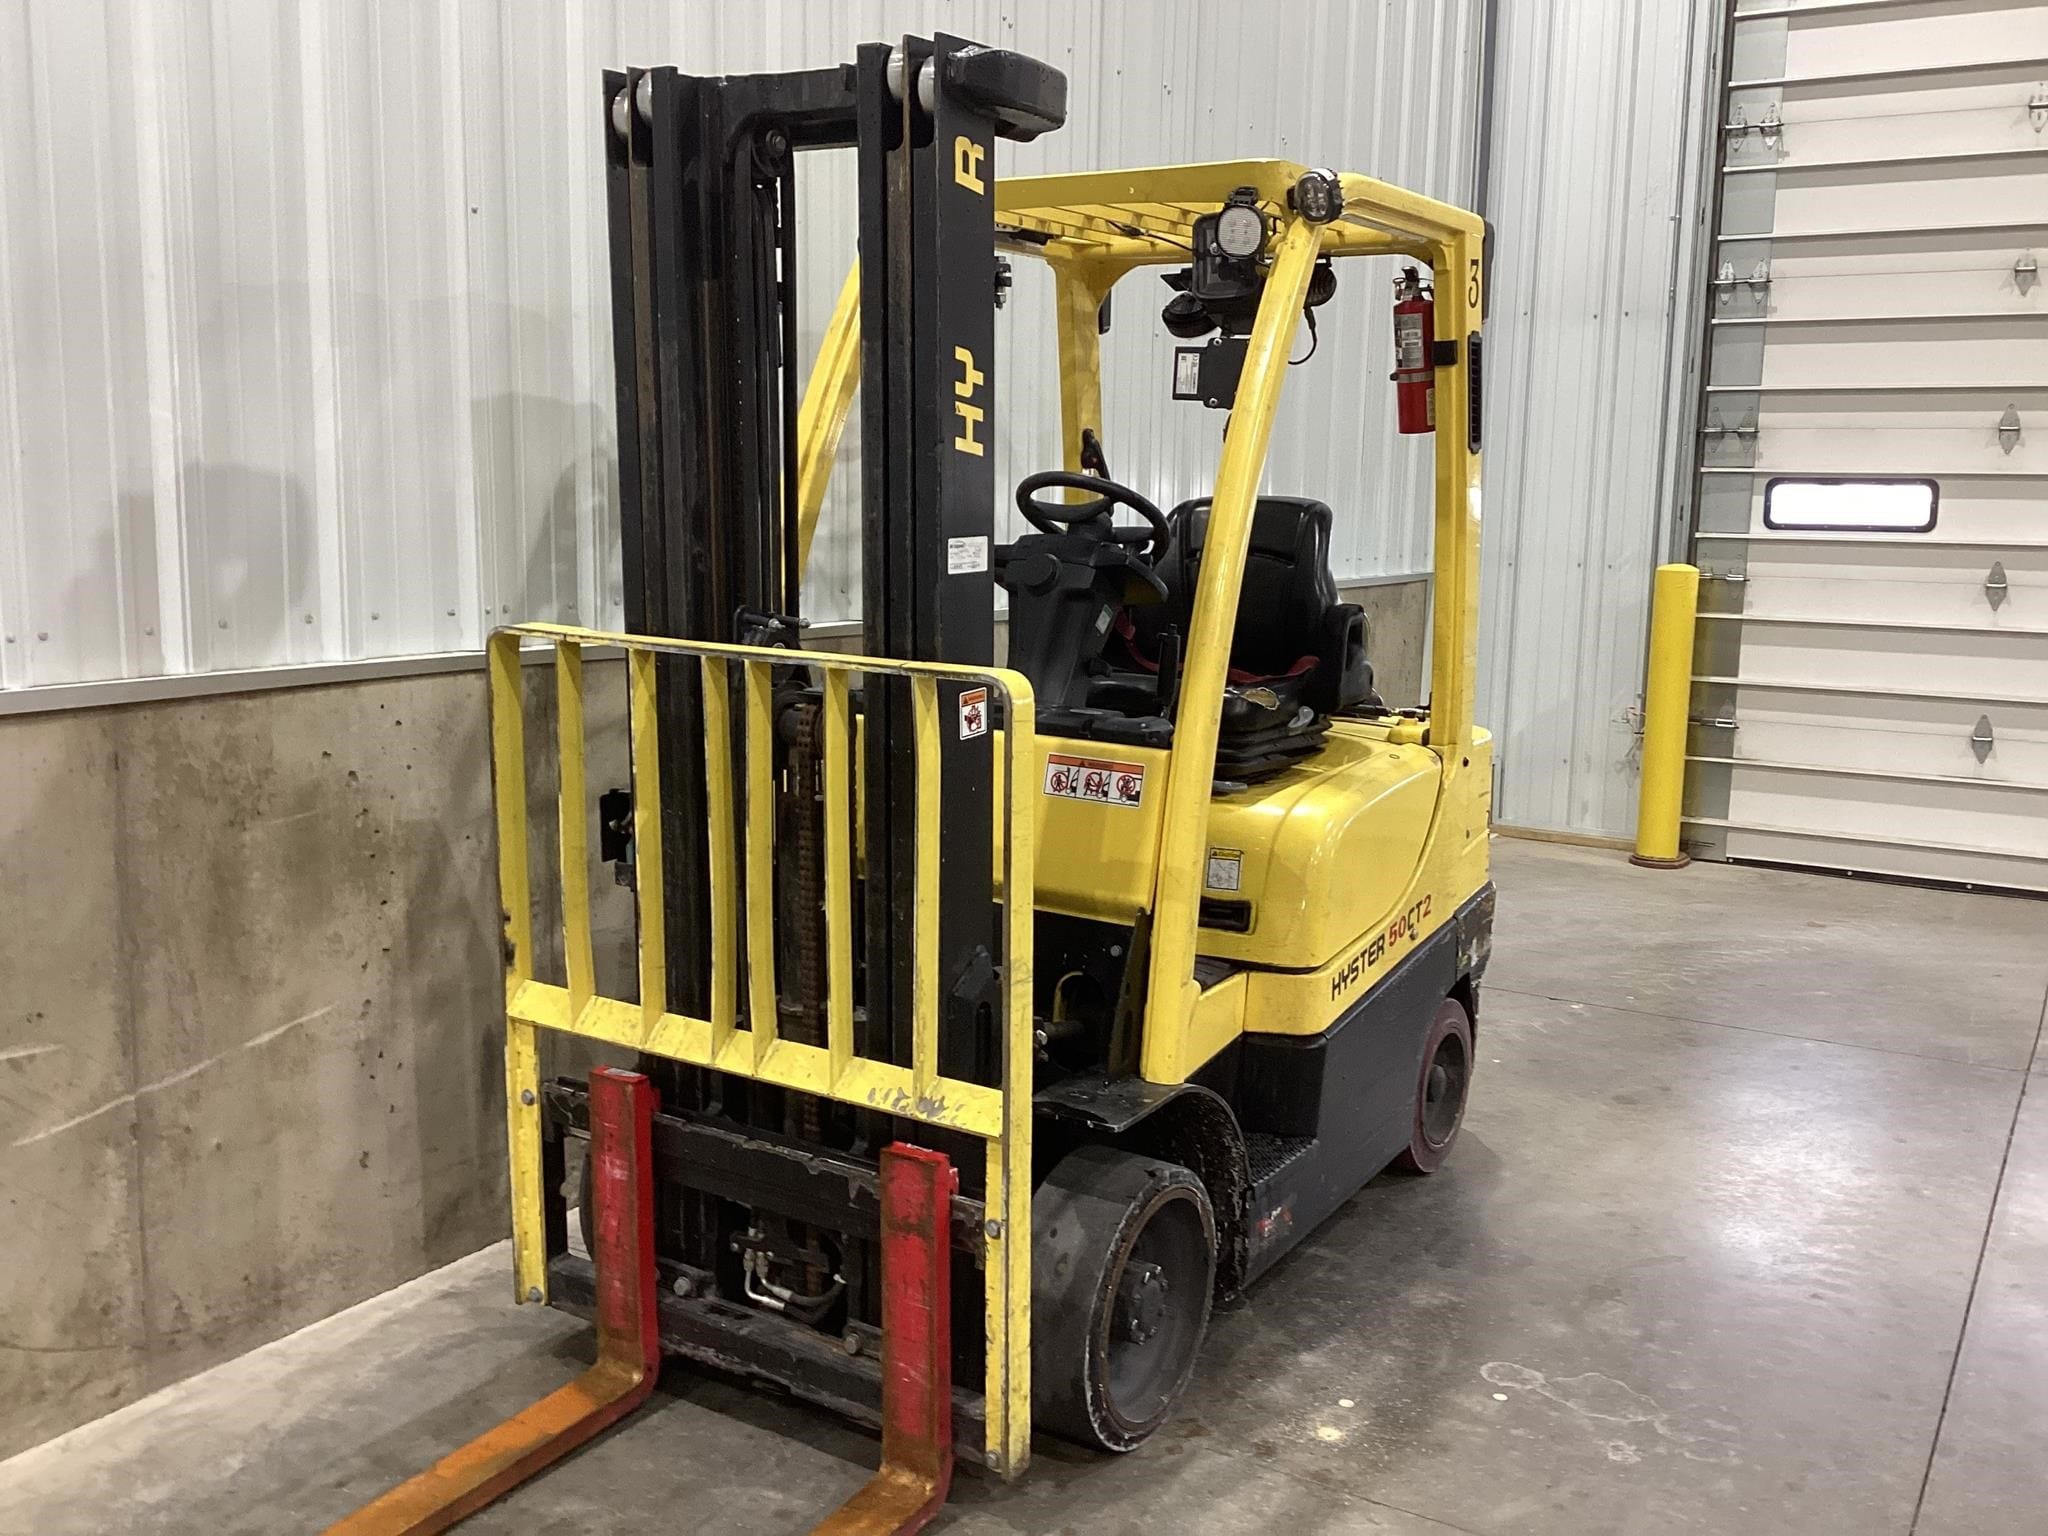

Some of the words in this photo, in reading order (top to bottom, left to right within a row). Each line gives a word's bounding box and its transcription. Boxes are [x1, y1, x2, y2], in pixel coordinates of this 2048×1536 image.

[1468, 259, 1479, 308] 3
[1331, 933, 1385, 1001] HYSTER
[1388, 894, 1432, 947] 50CT2
